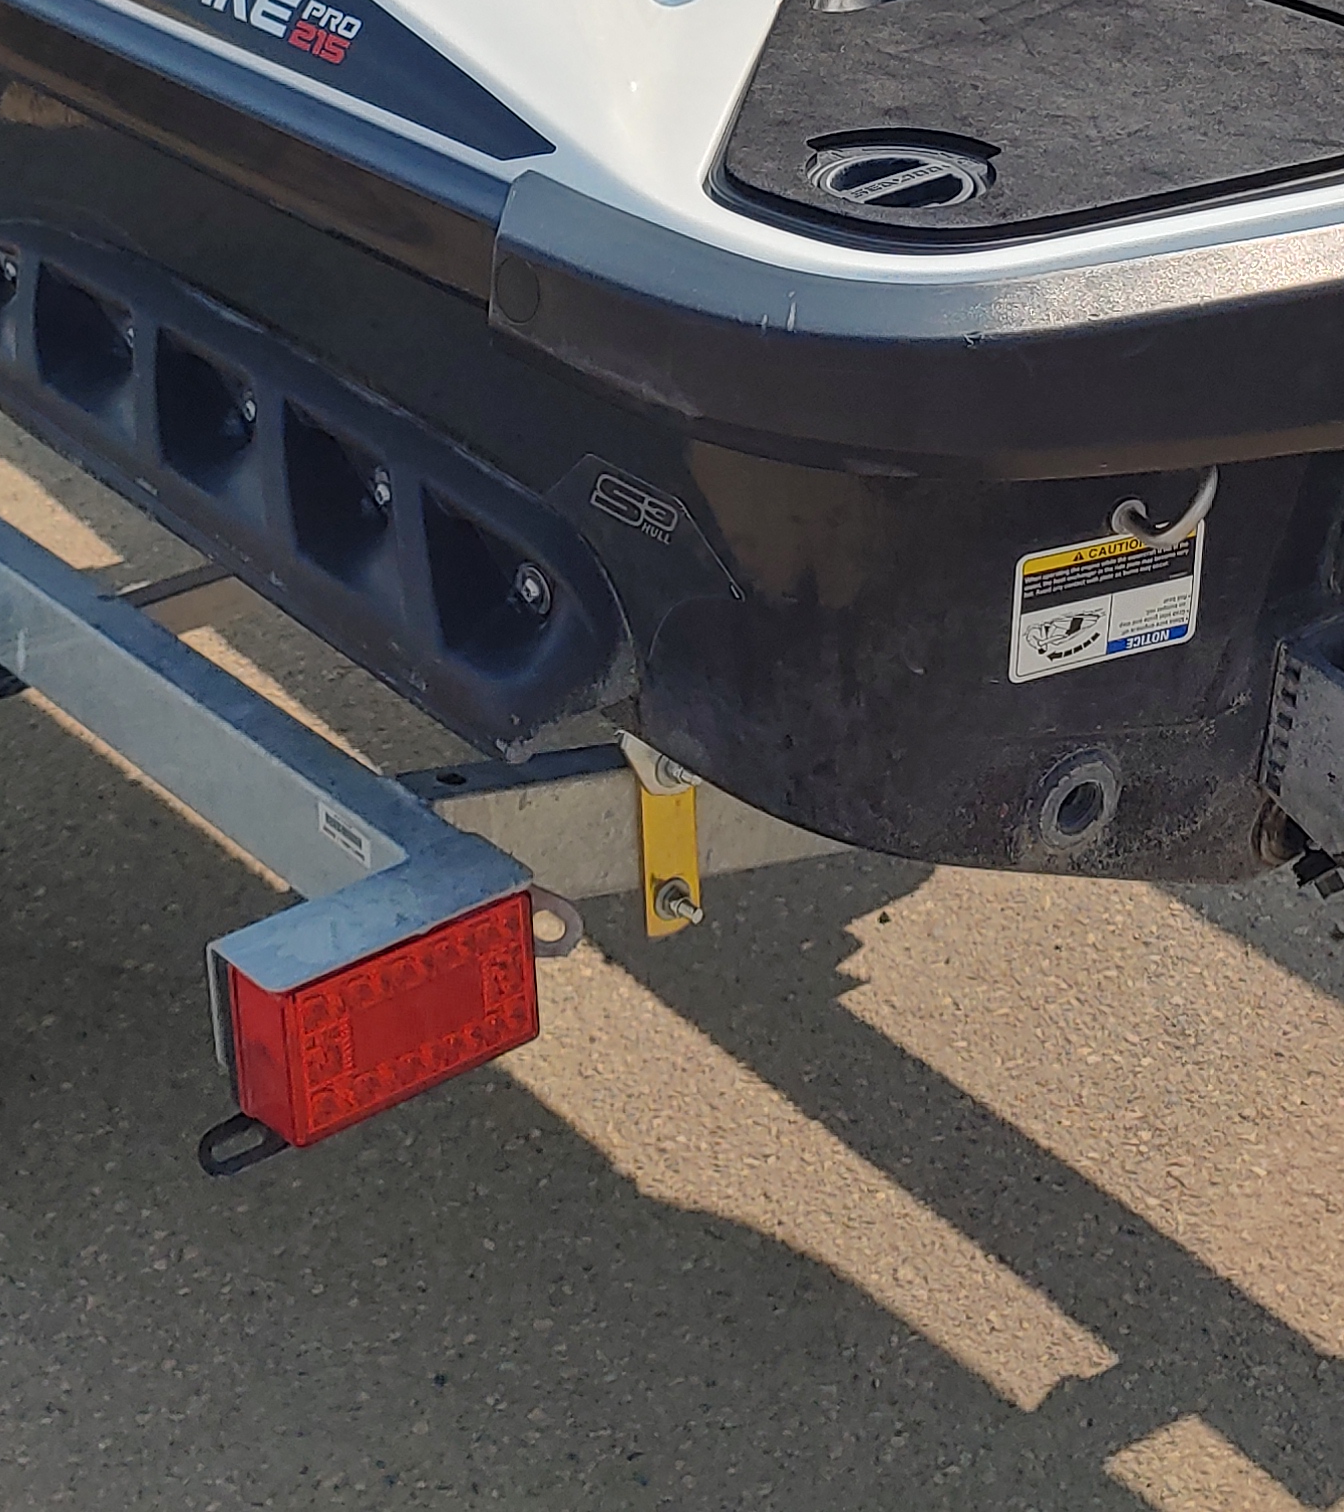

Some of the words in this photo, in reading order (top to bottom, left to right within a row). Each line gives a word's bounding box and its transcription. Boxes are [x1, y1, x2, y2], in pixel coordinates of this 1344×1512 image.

[302, 0, 362, 39] PRO
[287, 21, 351, 64] 215
[640, 521, 671, 546] HULL
[1126, 628, 1170, 650] NOTICE
